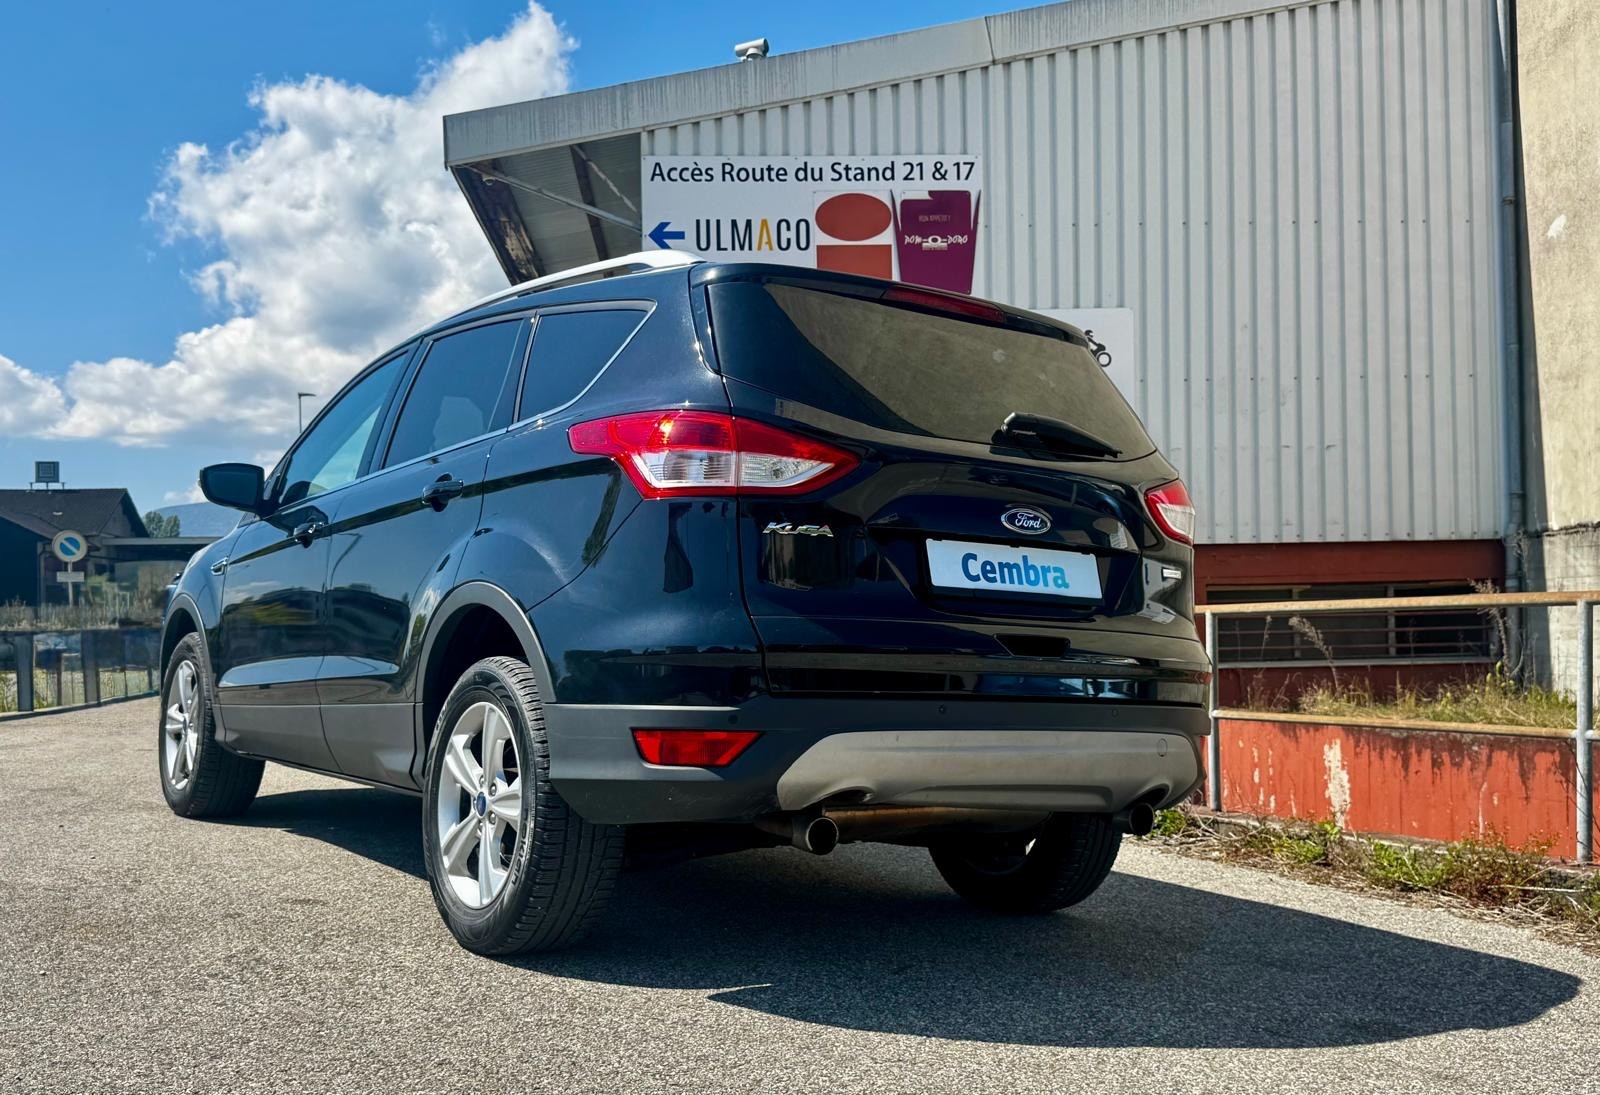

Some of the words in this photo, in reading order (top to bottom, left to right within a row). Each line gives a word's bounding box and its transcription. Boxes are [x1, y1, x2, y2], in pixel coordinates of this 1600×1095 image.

[650, 161, 715, 183] Accès
[721, 161, 788, 183] Route
[794, 161, 824, 183] du
[830, 161, 896, 183] Stand
[902, 161, 924, 181] 21
[931, 160, 948, 181] &
[952, 161, 975, 181] 17
[695, 218, 811, 252] ULMACO
[762, 522, 834, 537] KUGA
[1015, 512, 1041, 528] Ford
[961, 553, 1071, 589] Cembra
